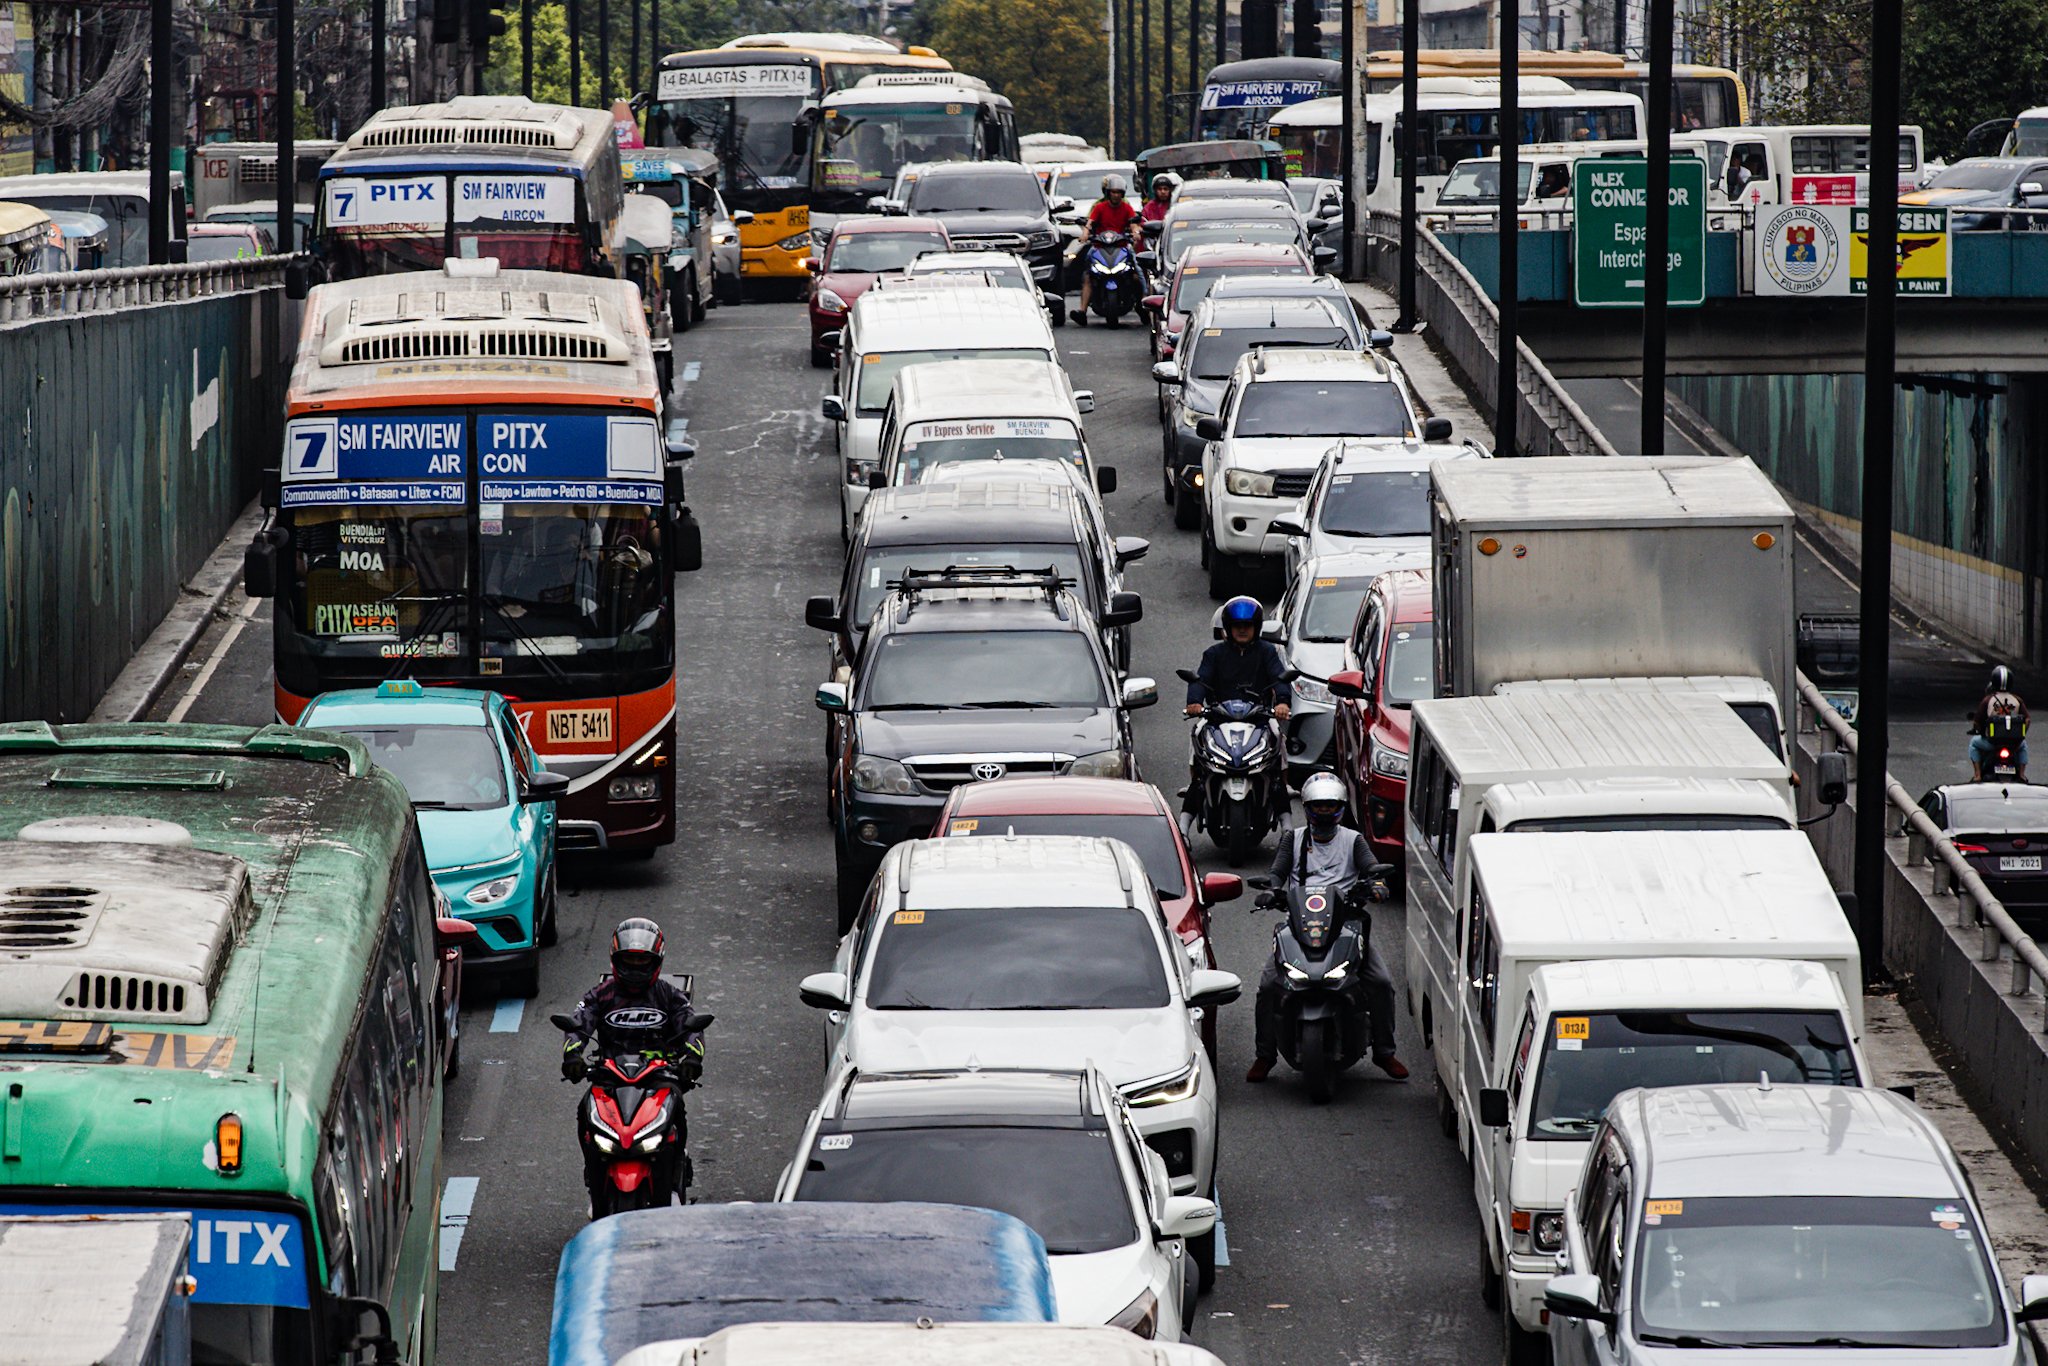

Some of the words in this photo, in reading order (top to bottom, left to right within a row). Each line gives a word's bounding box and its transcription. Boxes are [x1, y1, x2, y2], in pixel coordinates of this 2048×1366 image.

[678, 71, 747, 86] BALAGTAS
[759, 69, 790, 82] PITX
[791, 70, 806, 82] 14
[1205, 86, 1218, 107] 7
[1220, 84, 1236, 96] SM
[1236, 83, 1285, 95] FAIRVIEW
[1291, 82, 1316, 94] PITX
[1244, 96, 1284, 105] AIRCON
[203, 160, 229, 178] ICE
[635, 161, 665, 170] SAVES
[1591, 172, 1625, 187] NLEX
[463, 183, 482, 200] SM
[486, 182, 546, 200] FAIRVIEW
[1591, 187, 1690, 208] CONNEOR
[334, 193, 354, 218] 7
[371, 183, 435, 201] PITX
[502, 210, 545, 221] AIRCON
[1856, 213, 1941, 231] BSEN
[1765, 209, 1793, 248] LUNGSOD
[1795, 209, 1808, 218] NG
[1809, 211, 1836, 247] MAYNILA
[1599, 249, 1682, 272] Interchge
[1780, 278, 1823, 292] PILIPINAS
[1909, 281, 1942, 291] PAINT
[934, 424, 963, 437] Express
[966, 423, 995, 435] Service
[295, 432, 327, 468] 7
[339, 424, 366, 450] SM
[372, 423, 461, 449] FAIRVIEW
[493, 423, 548, 449] PITX
[428, 454, 461, 473] AIR
[482, 453, 526, 473] CON
[284, 486, 350, 502] Commonwealth
[360, 486, 399, 500] Batasan
[408, 486, 431, 499] Litex
[441, 486, 461, 499] FCM
[484, 484, 513, 500] Quiapo
[521, 485, 552, 498] Lawton
[559, 485, 585, 498] Pedro
[586, 485, 598, 498] Gil
[605, 485, 639, 499] Buendia
[340, 524, 374, 536] BUENDIA
[340, 551, 385, 571] MOA
[316, 604, 353, 633] PITX
[353, 604, 397, 617] ASEANA
[353, 617, 397, 626] DFA
[387, 683, 414, 693] TAXI
[550, 712, 577, 738] NBT
[582, 711, 609, 738] 5411
[2020, 859, 2040, 867] 2021
[614, 1013, 657, 1023] HJC
[1565, 1024, 1586, 1034] 013A
[190, 1220, 291, 1267] ITX
